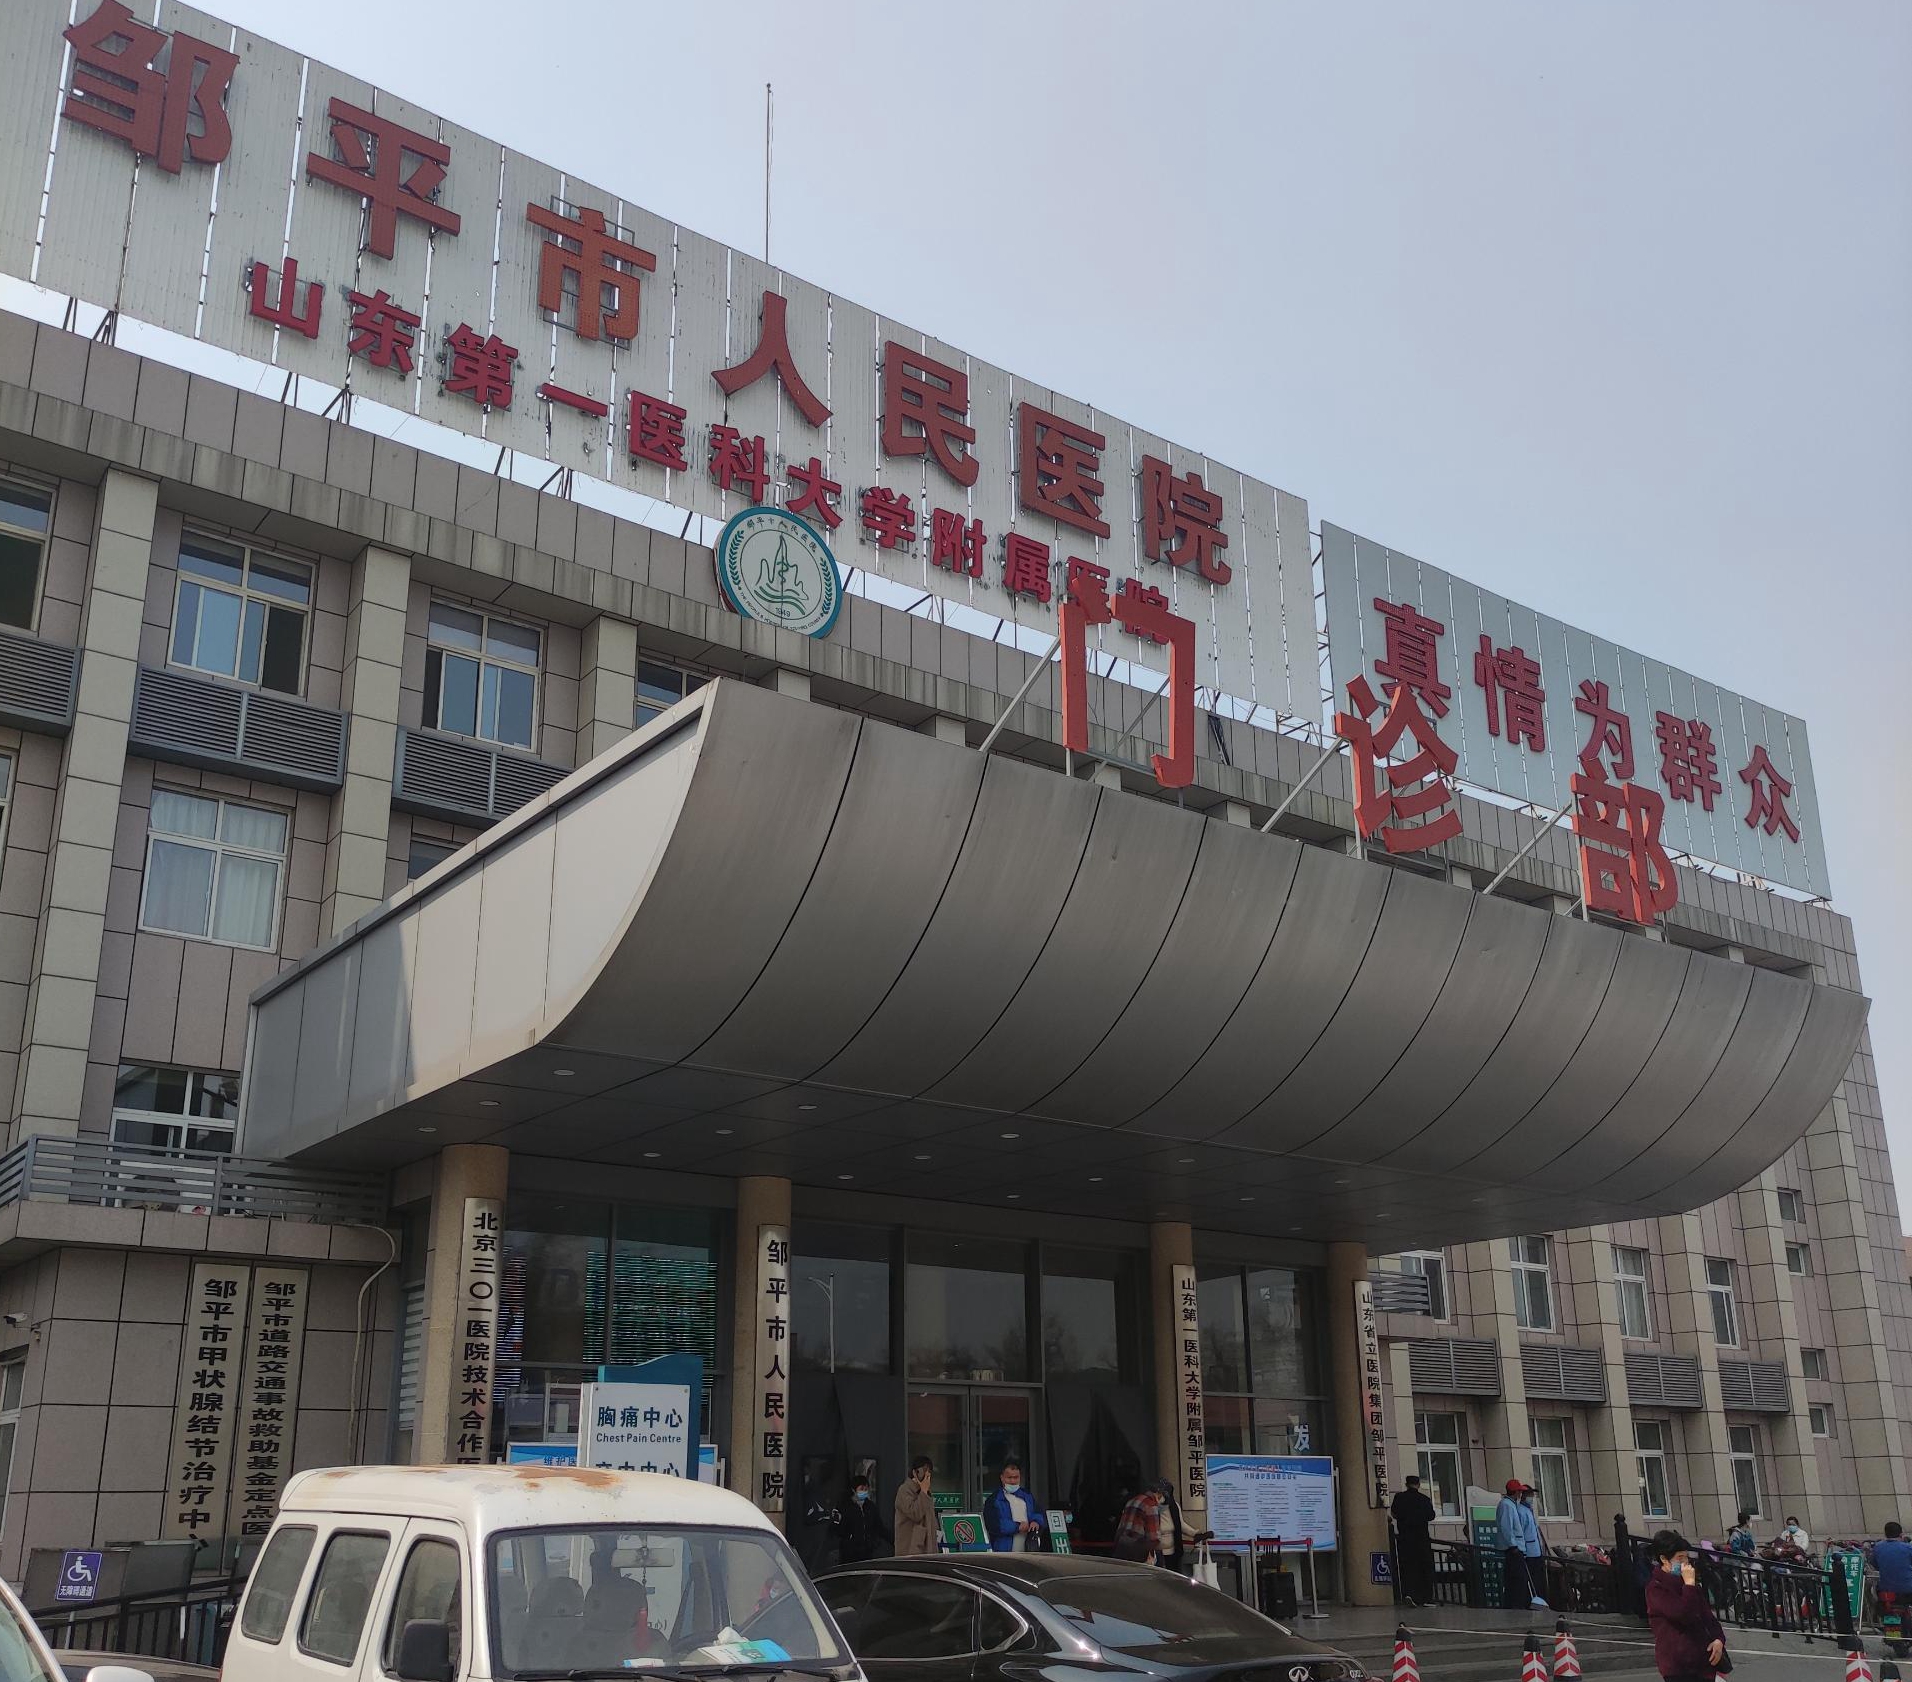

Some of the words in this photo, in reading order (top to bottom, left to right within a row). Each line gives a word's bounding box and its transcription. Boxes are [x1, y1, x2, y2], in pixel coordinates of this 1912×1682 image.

[61, 0, 1231, 585] 邹平市人民医院
[1059, 575, 1678, 927] 门诊部
[1373, 597, 1801, 844] 真情为群众
[596, 1432, 624, 1443] Chest
[627, 1433, 647, 1443] Pain
[650, 1433, 681, 1443] Centre
[597, 1406, 683, 1428] 胸痛中心
[762, 1239, 788, 1499] 邹平市人民医院
[1181, 1277, 1206, 1498] 山东第一医科大学附属邹平医院
[1294, 1424, 1310, 1450] 发
[1361, 1289, 1389, 1498] 山东省立医院集团邹平医院
